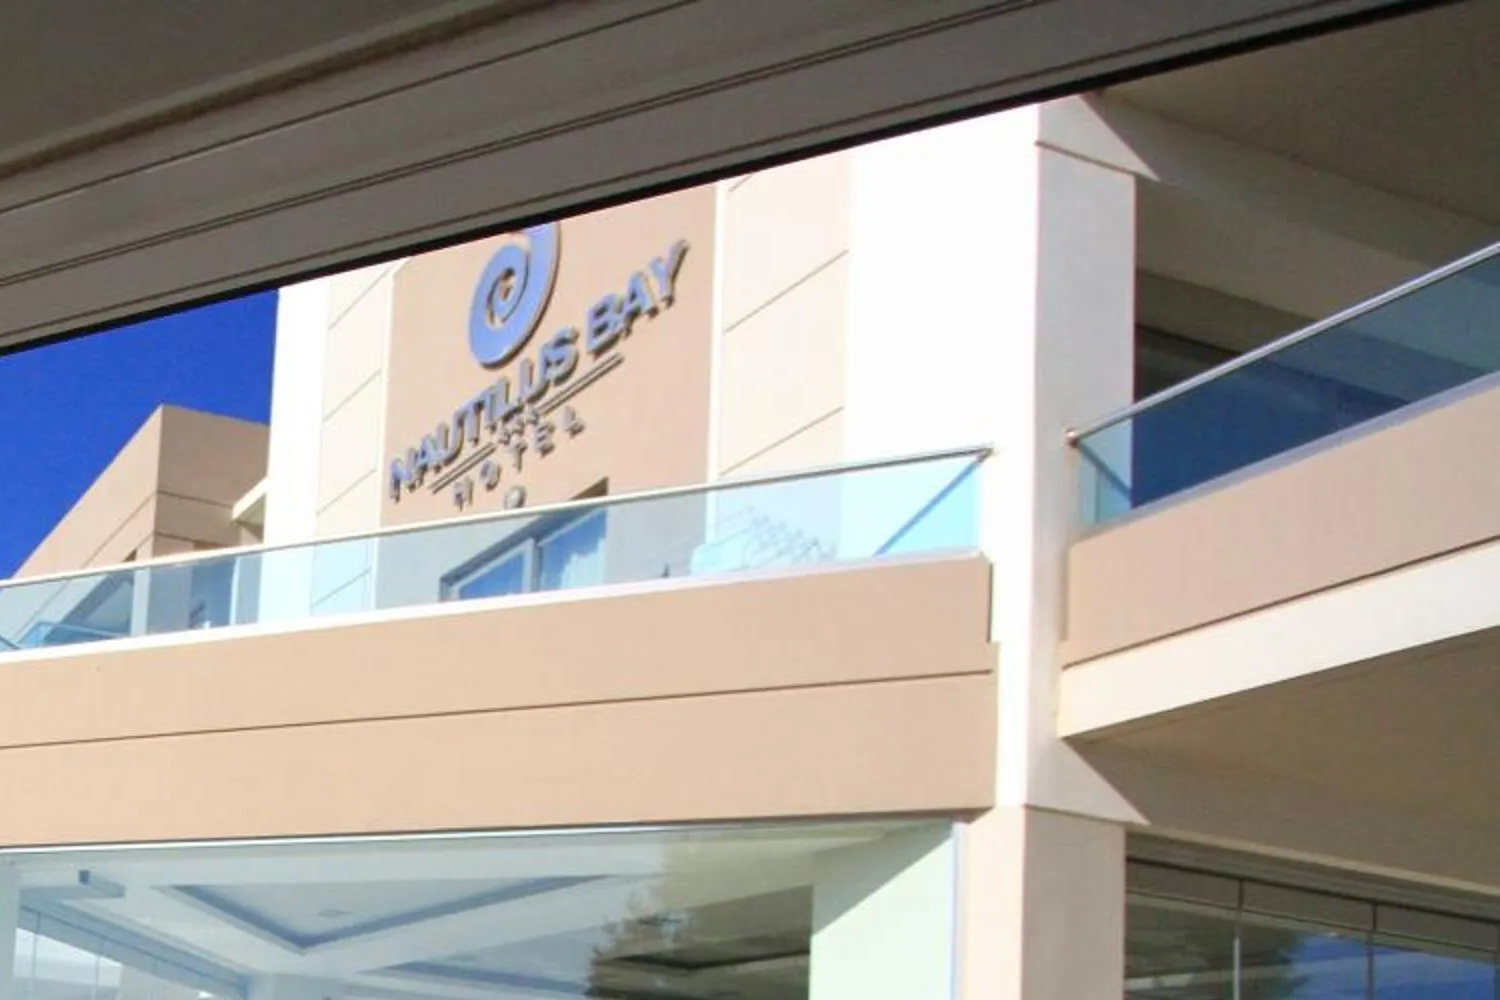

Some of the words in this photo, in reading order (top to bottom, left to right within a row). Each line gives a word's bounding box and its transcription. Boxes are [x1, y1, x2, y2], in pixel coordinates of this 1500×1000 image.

[389, 326, 579, 503] NAUTILUS
[586, 237, 690, 362] BAY
[453, 404, 586, 511] HOTEL
